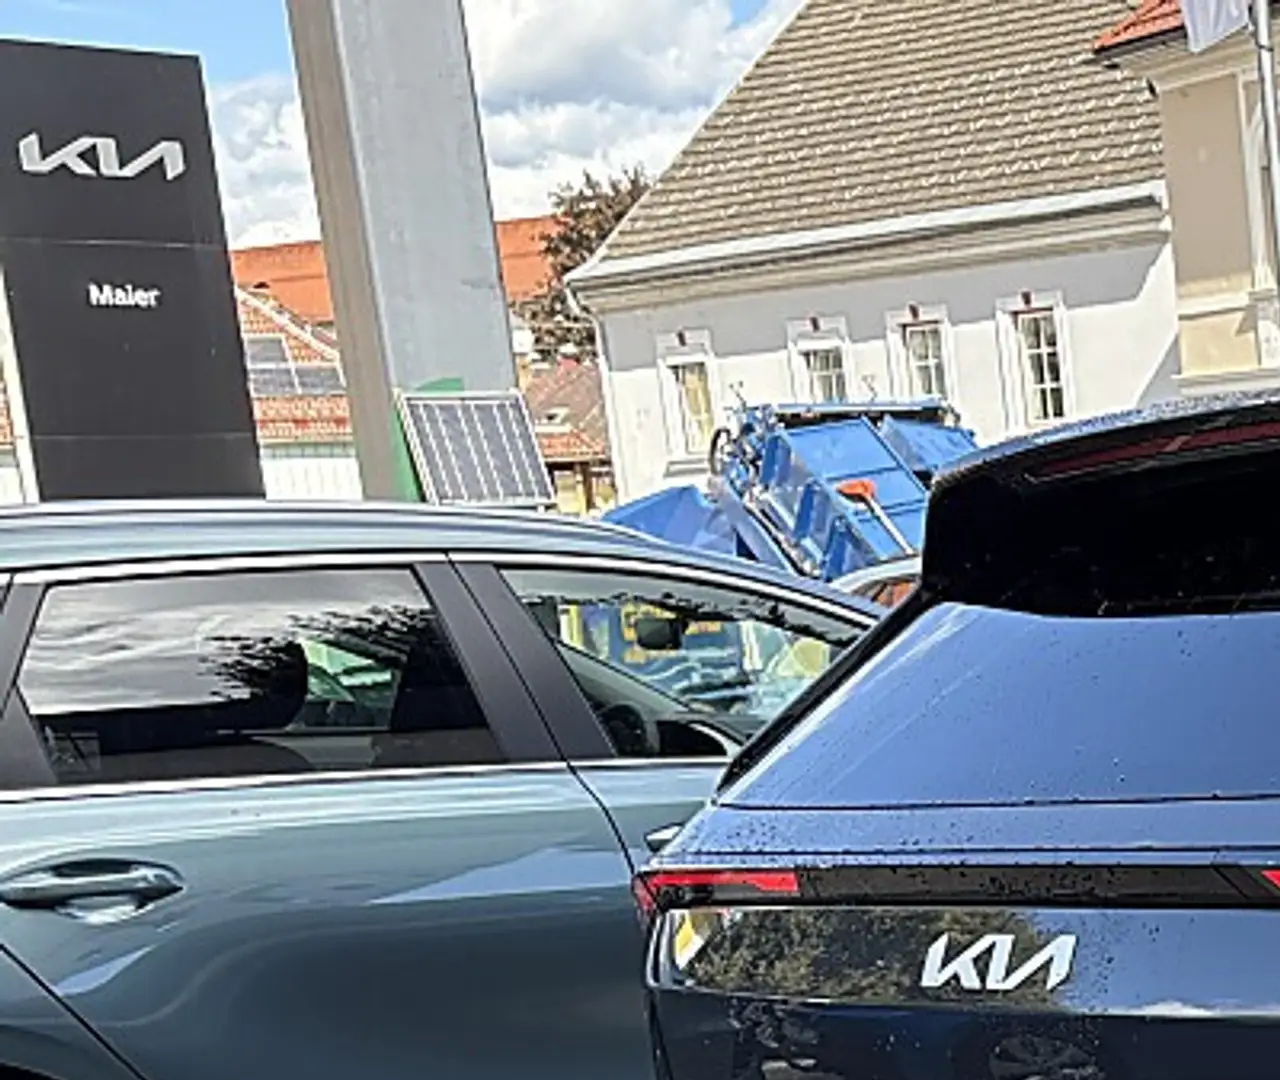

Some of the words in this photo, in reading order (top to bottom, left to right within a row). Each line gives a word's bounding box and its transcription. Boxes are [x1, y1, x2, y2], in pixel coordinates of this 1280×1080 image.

[19, 132, 186, 181] KIA
[88, 283, 160, 307] Maier
[920, 932, 1077, 990] KIA
